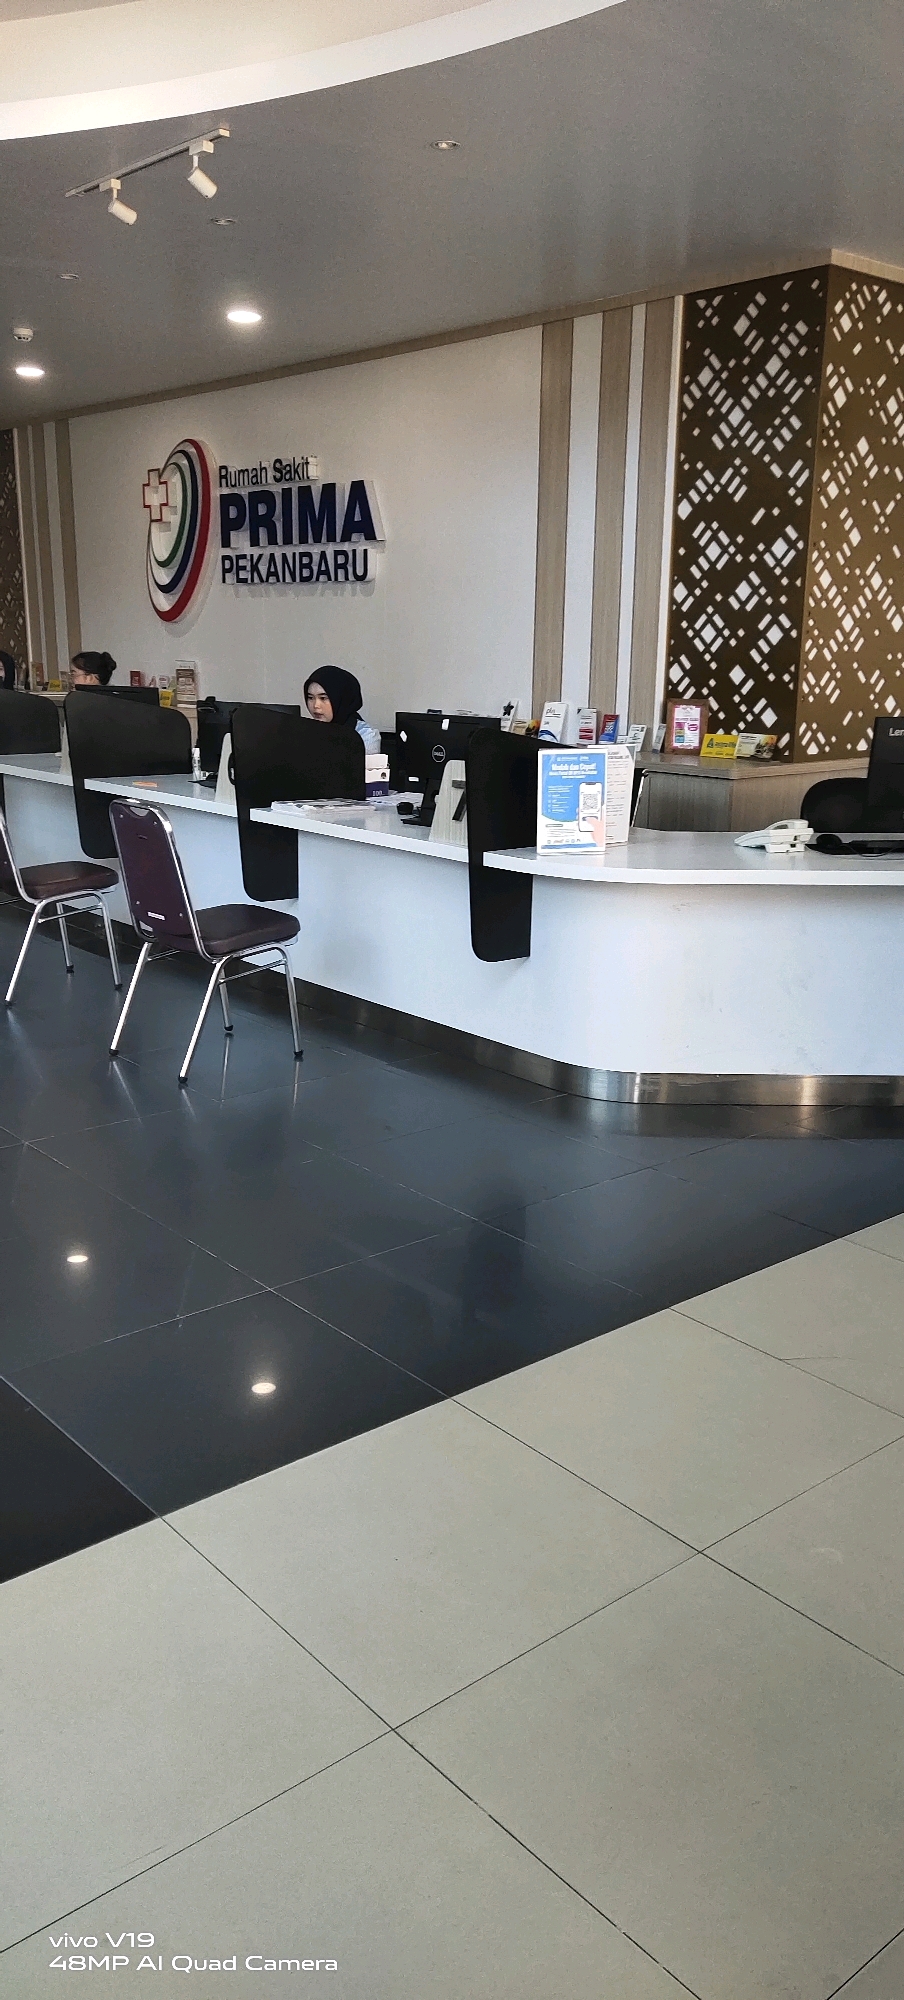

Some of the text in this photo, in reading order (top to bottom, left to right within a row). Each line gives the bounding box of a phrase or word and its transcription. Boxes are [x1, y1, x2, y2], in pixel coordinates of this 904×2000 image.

[219, 456, 310, 488] Rumah Sakit
[220, 480, 378, 548] PRIMA
[221, 549, 369, 584] PEKANBARU
[452, 780, 466, 822] 7
